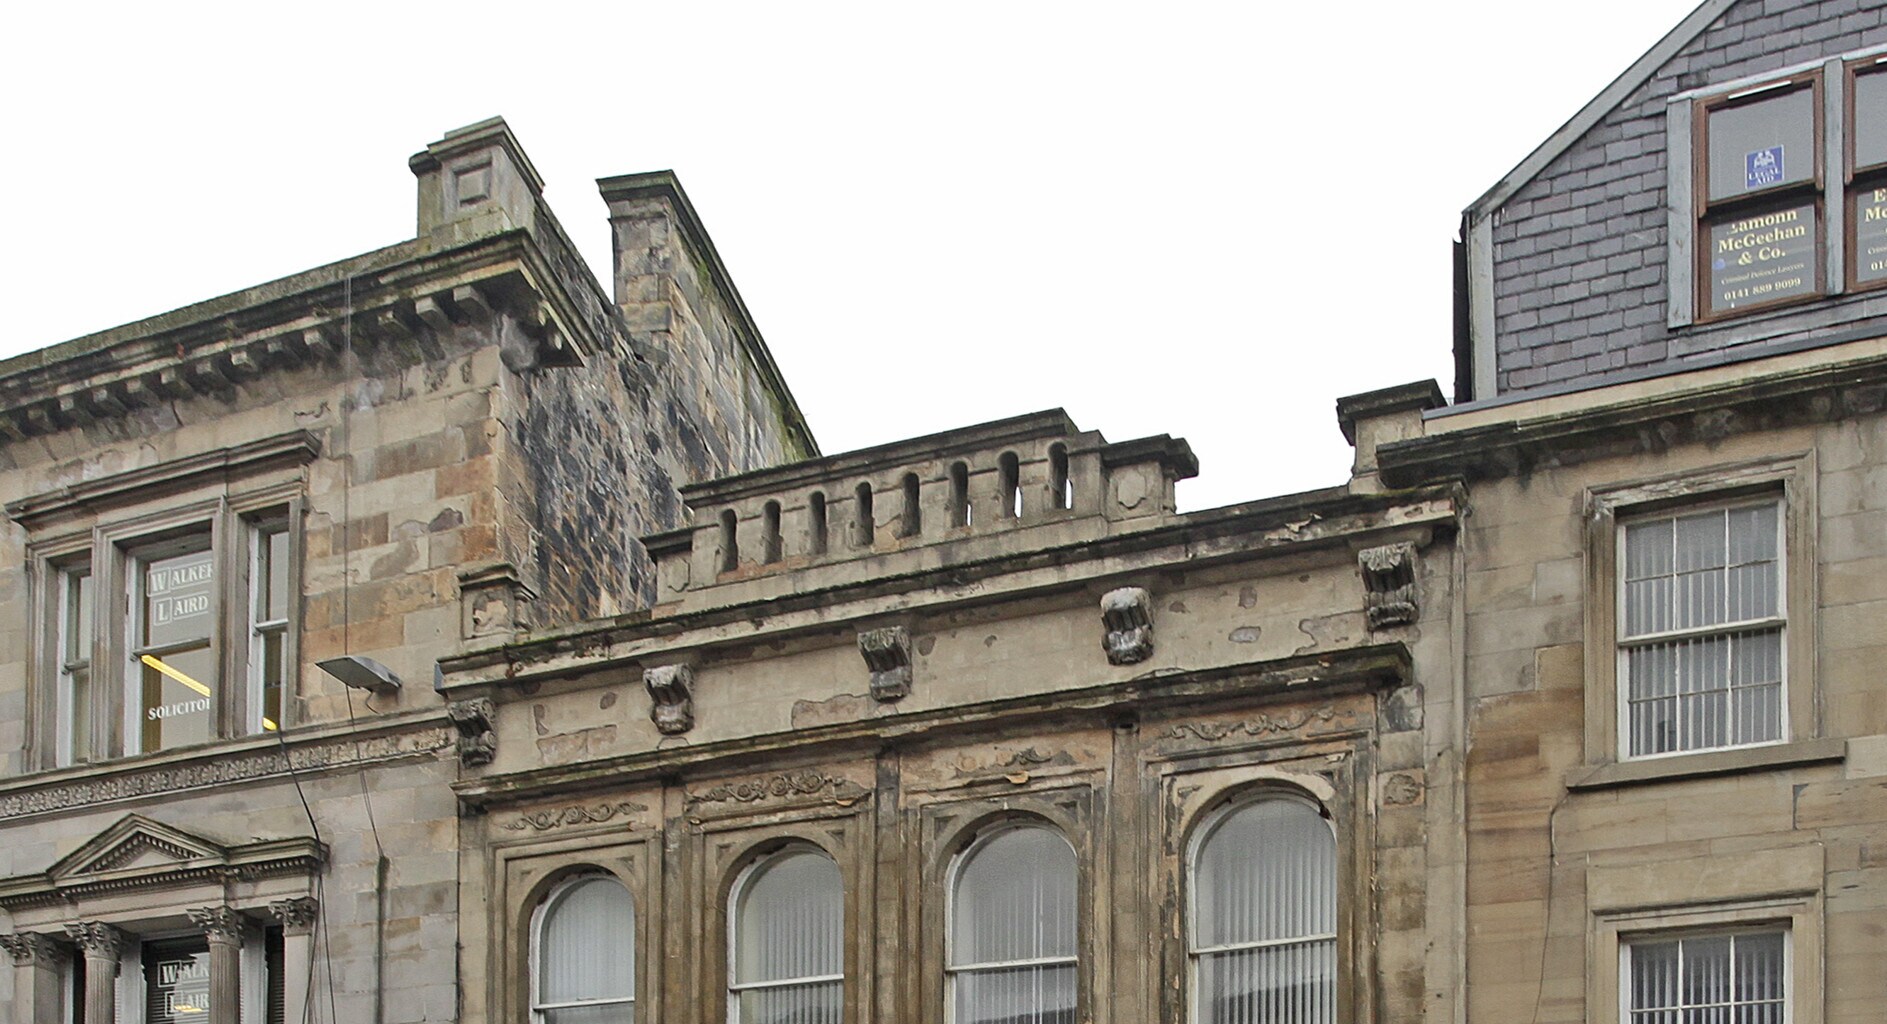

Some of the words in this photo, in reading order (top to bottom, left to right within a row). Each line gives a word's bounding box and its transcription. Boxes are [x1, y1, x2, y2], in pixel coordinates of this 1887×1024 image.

[1718, 225, 1806, 253] McGeehan
[1738, 251, 1753, 266] &
[1758, 246, 1786, 261] Co.
[1724, 288, 1750, 301] 0141
[1752, 283, 1773, 296] 889
[1774, 277, 1801, 291] 9099
[158, 595, 209, 621] LAIRD
